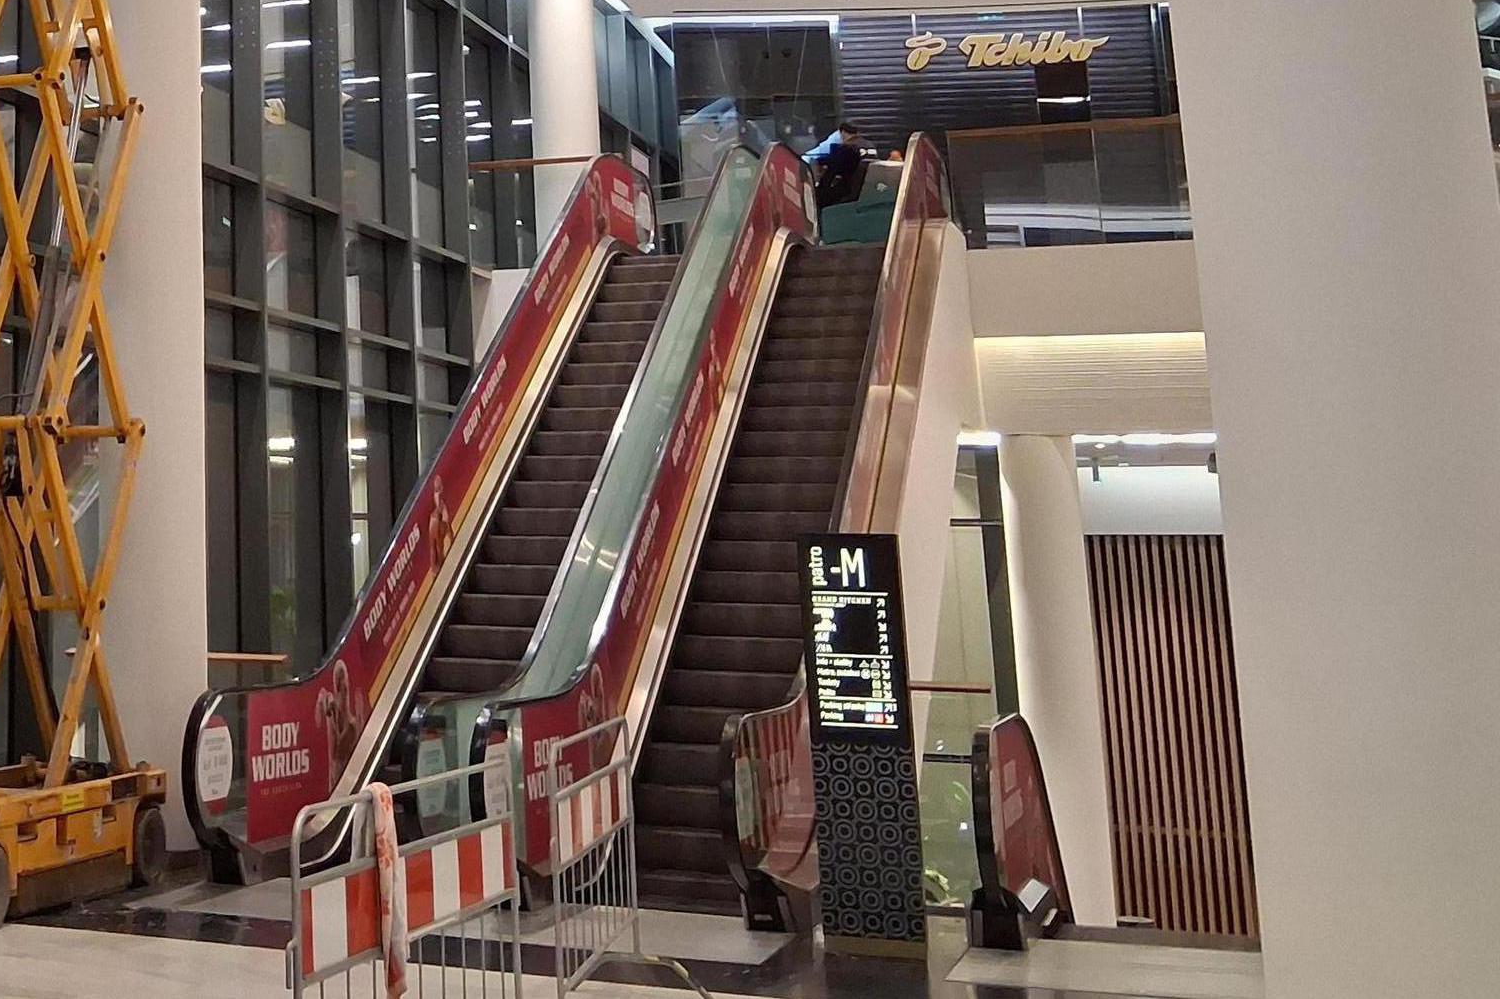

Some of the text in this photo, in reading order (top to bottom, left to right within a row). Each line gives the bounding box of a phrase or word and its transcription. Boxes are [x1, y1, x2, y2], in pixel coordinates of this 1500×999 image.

[959, 31, 1110, 67] Tchibo
[636, 498, 660, 571] WORLDS
[363, 585, 387, 643] BODY
[386, 522, 421, 594] WORLDS
[808, 546, 828, 586] patro
[262, 721, 300, 751] BODY
[252, 748, 310, 783] WORLDS
